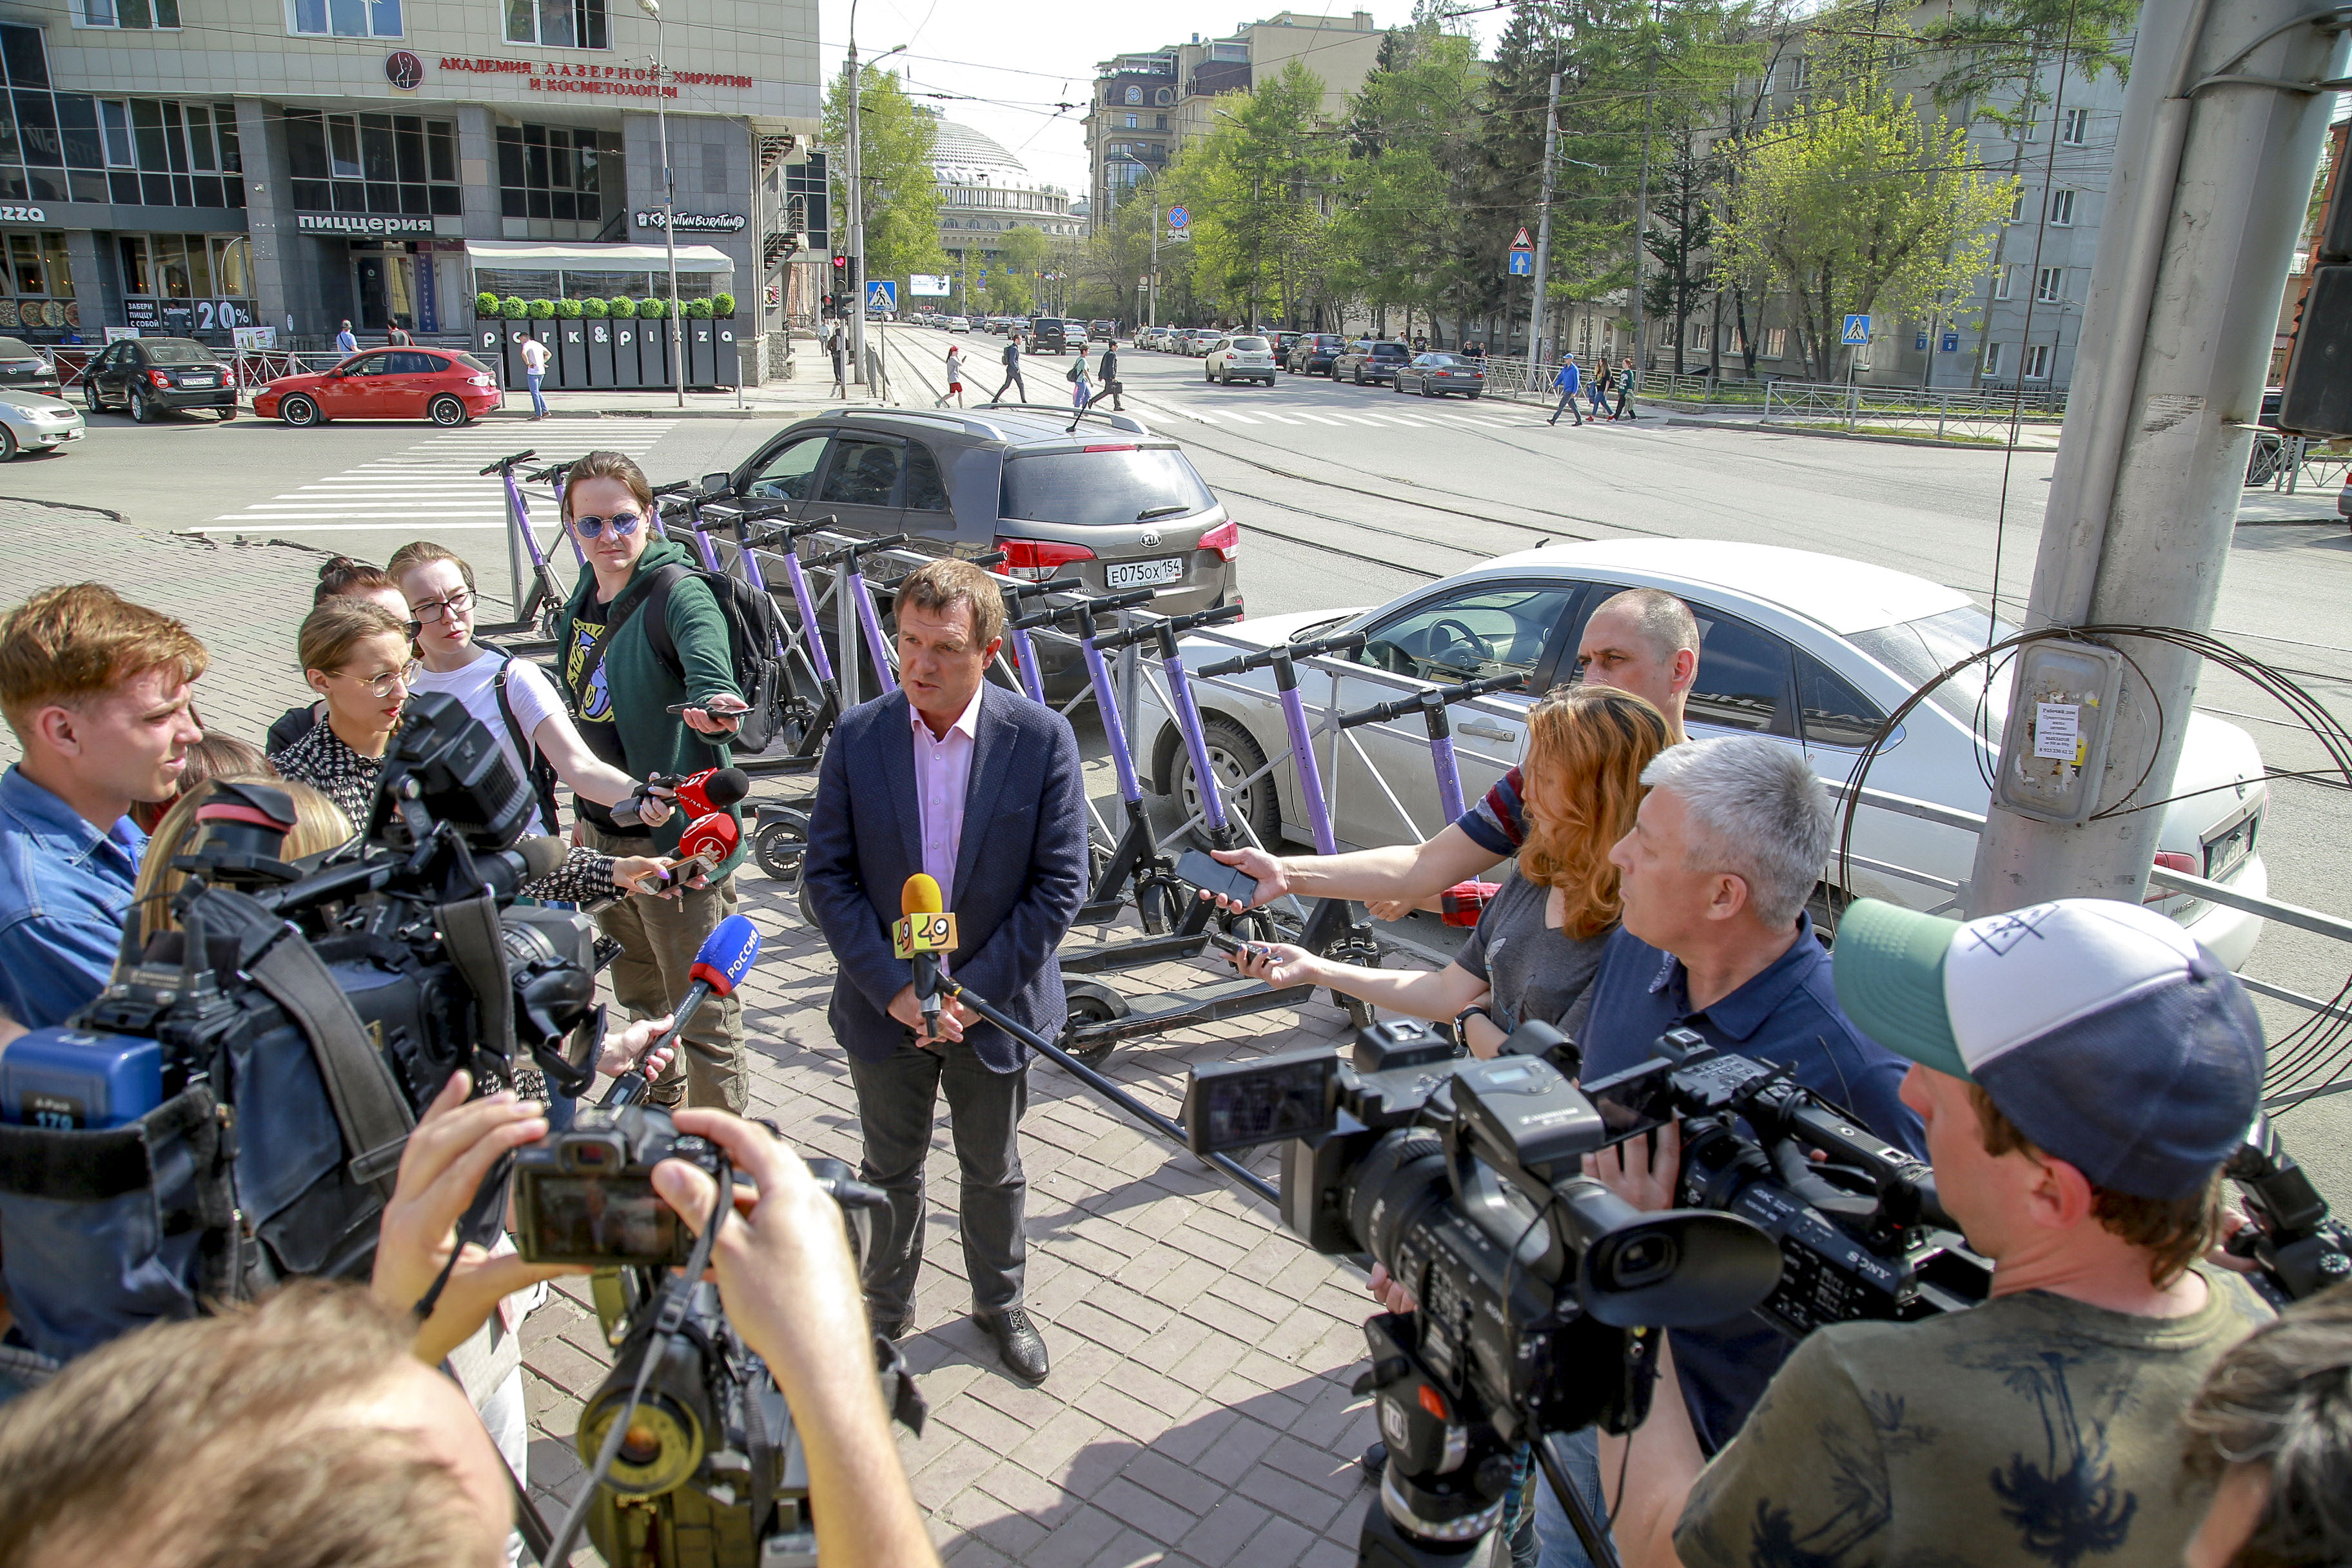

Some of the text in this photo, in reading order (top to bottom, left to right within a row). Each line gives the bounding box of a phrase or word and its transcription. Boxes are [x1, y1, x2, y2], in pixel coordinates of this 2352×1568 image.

[439, 57, 532, 74] АКАДЕМИЯ
[672, 70, 753, 88] ХИРУРГИИ
[529, 77, 678, 98] И КОСМЕТОЛОГИИ
[298, 215, 433, 235] пиццерия
[1143, 535, 1160, 545] KIA
[1161, 560, 1179, 573] 154
[726, 928, 759, 979] РОССИЯ
[1846, 1250, 1892, 1280] SONY
